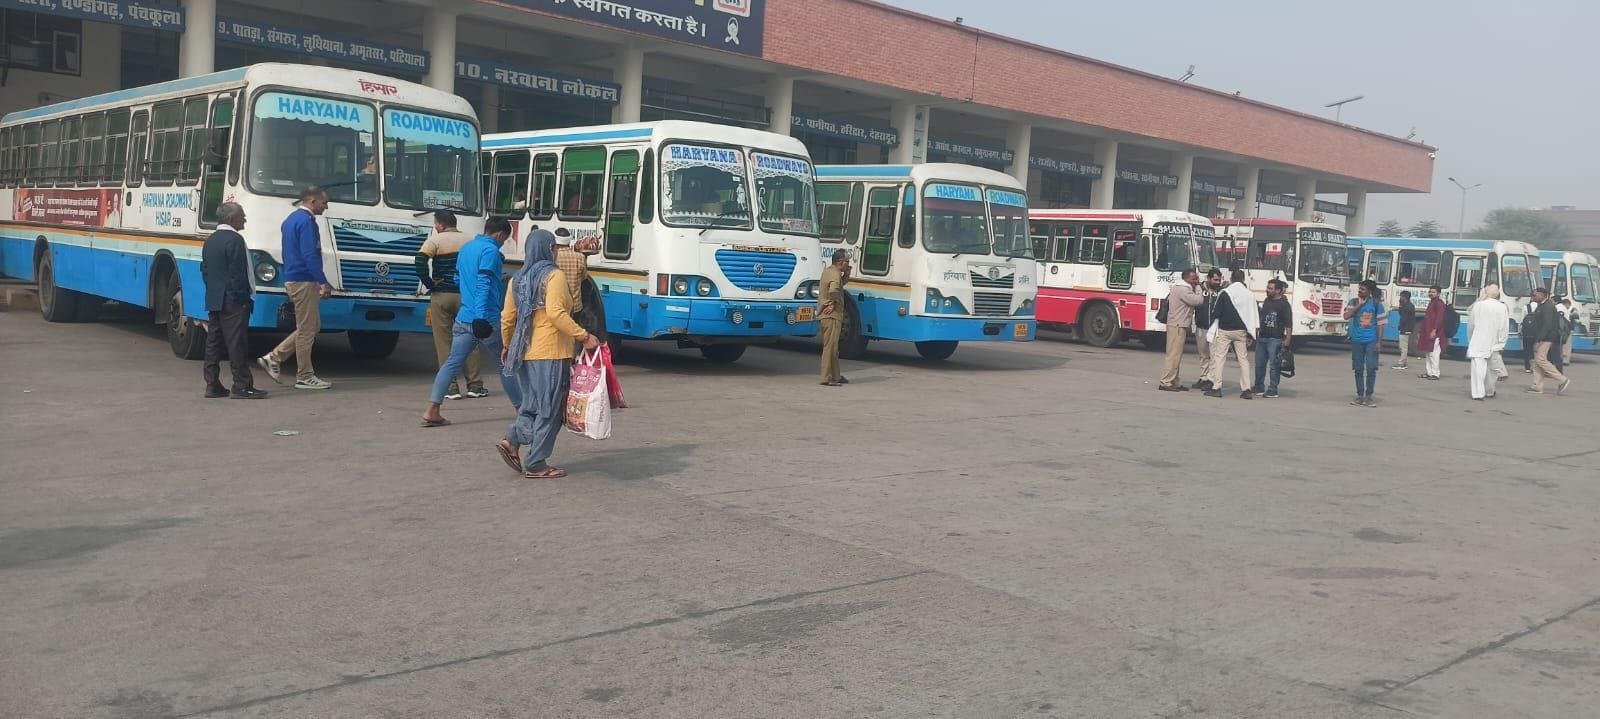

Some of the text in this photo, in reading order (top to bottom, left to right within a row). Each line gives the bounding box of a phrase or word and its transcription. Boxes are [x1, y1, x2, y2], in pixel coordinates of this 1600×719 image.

[128, 2, 181, 27] पंचकूला
[633, 8, 683, 31] करता
[218, 21, 230, 35] 9.
[455, 61, 618, 102] 10. नरवाना लोकल
[278, 96, 471, 138] HARYANA ROADWAYS
[670, 146, 809, 175] HARYANA ROADWAYS
[935, 185, 976, 201] HARYANA
